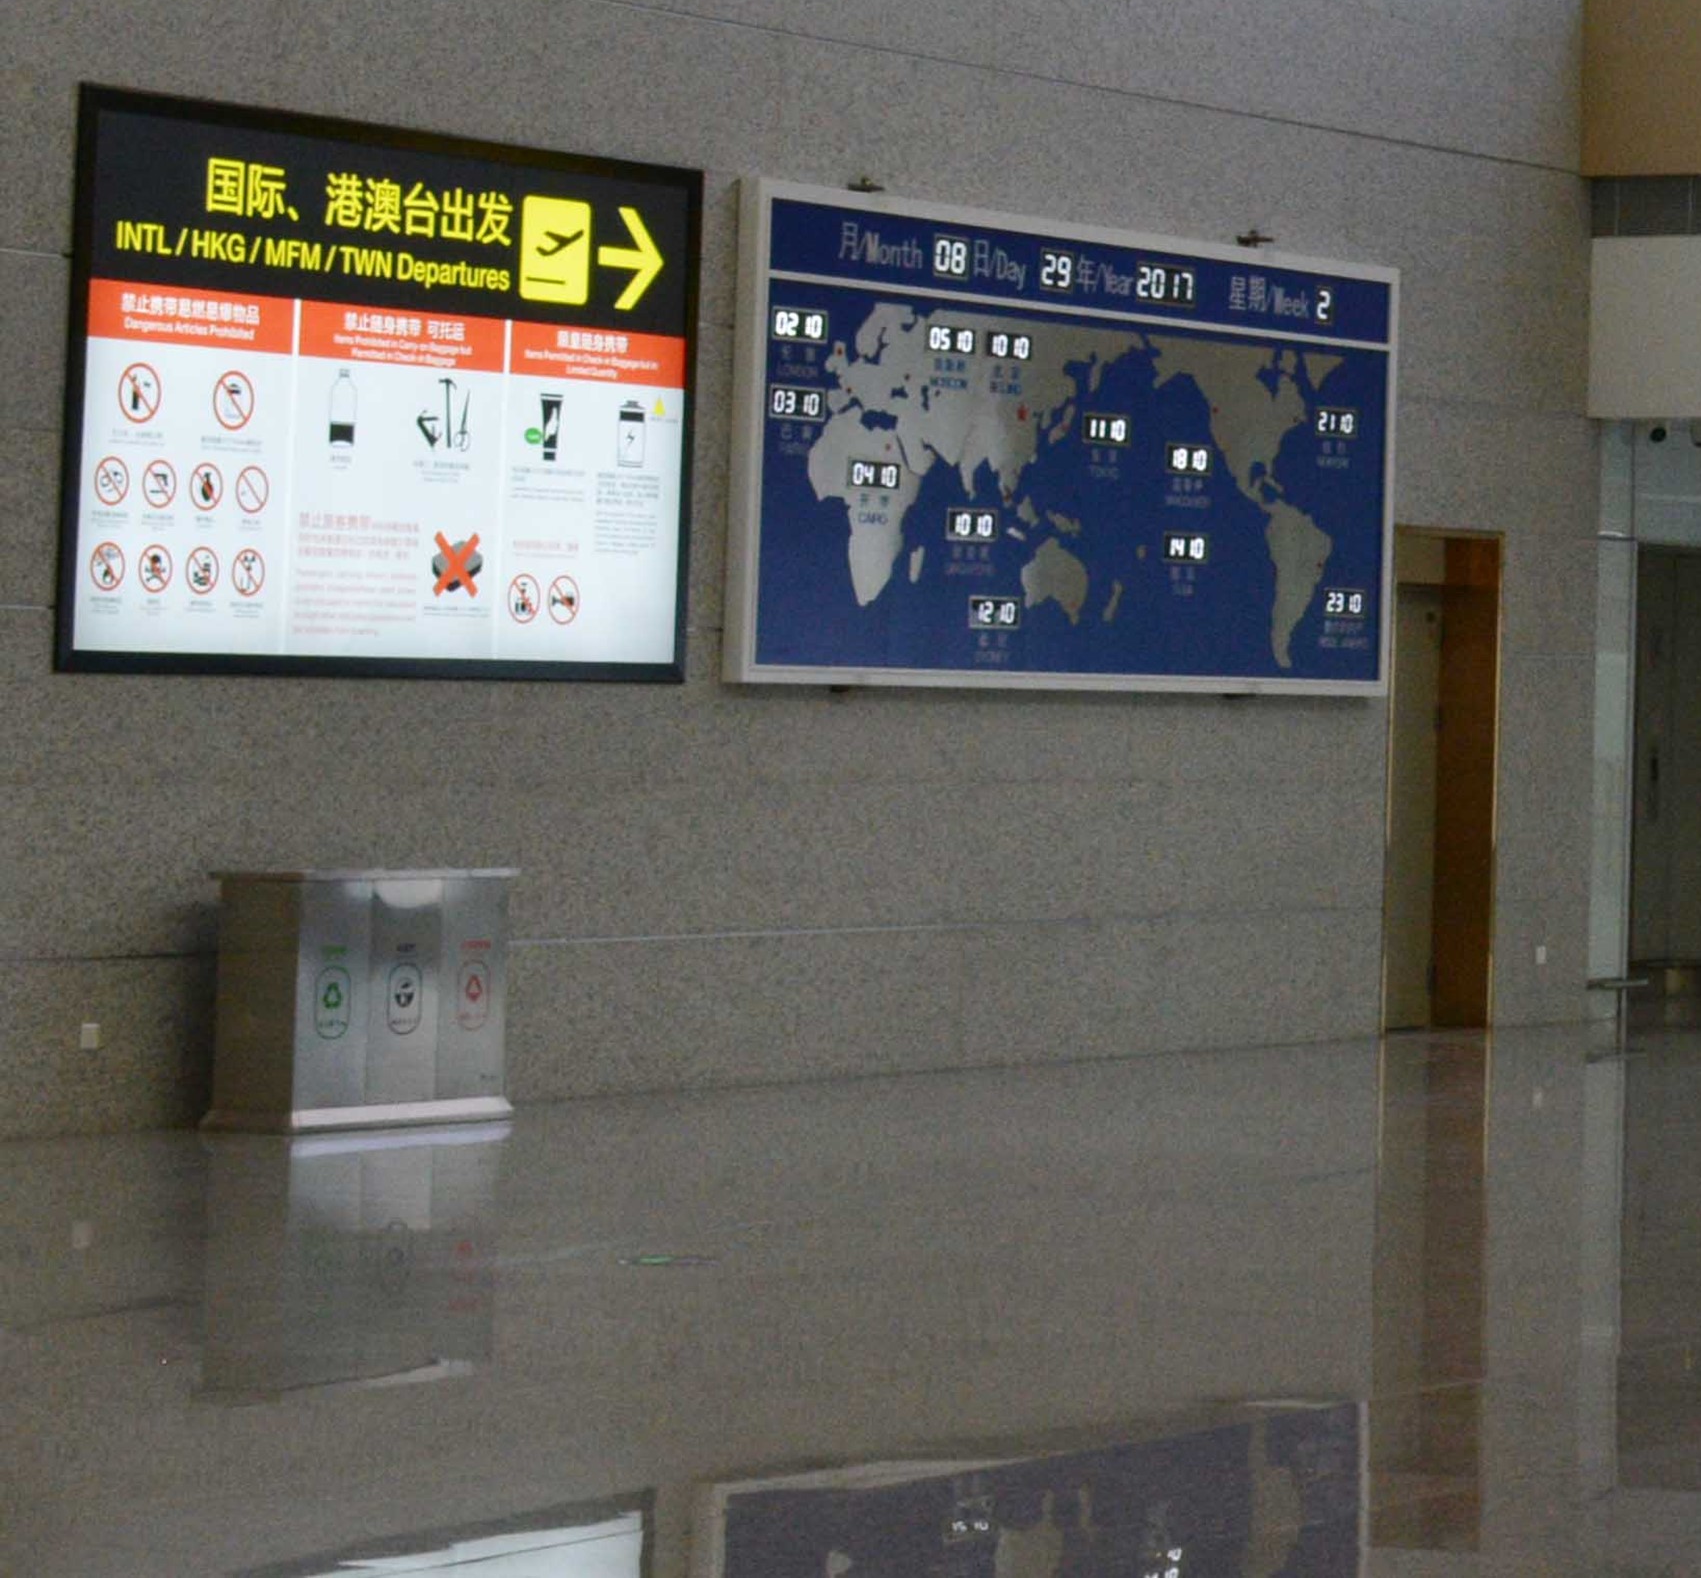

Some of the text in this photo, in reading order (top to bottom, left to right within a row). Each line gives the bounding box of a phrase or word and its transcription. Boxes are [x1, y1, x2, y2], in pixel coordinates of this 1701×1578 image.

[116, 220, 172, 256] INTL
[191, 229, 245, 264] HKG
[265, 240, 321, 273] MFM
[340, 248, 392, 279] TWN
[397, 253, 511, 291] Departures
[935, 240, 966, 274] 08
[1042, 254, 1071, 288] 29
[1136, 266, 1193, 300] 2017
[1316, 290, 1331, 319] 2
[775, 311, 822, 338] 02 10
[930, 327, 973, 353] 05 10
[991, 334, 1029, 359] 10 10
[773, 390, 819, 416] 03 10
[1089, 419, 1126, 442] 11 10
[1318, 412, 1335, 431] 21
[1192, 449, 1208, 471] 10
[852, 462, 897, 487] 04 10
[955, 513, 993, 536] 10 10
[1169, 537, 1205, 559] 14 10
[978, 600, 1015, 624] 12 10
[1326, 593, 1362, 613] 23 10
